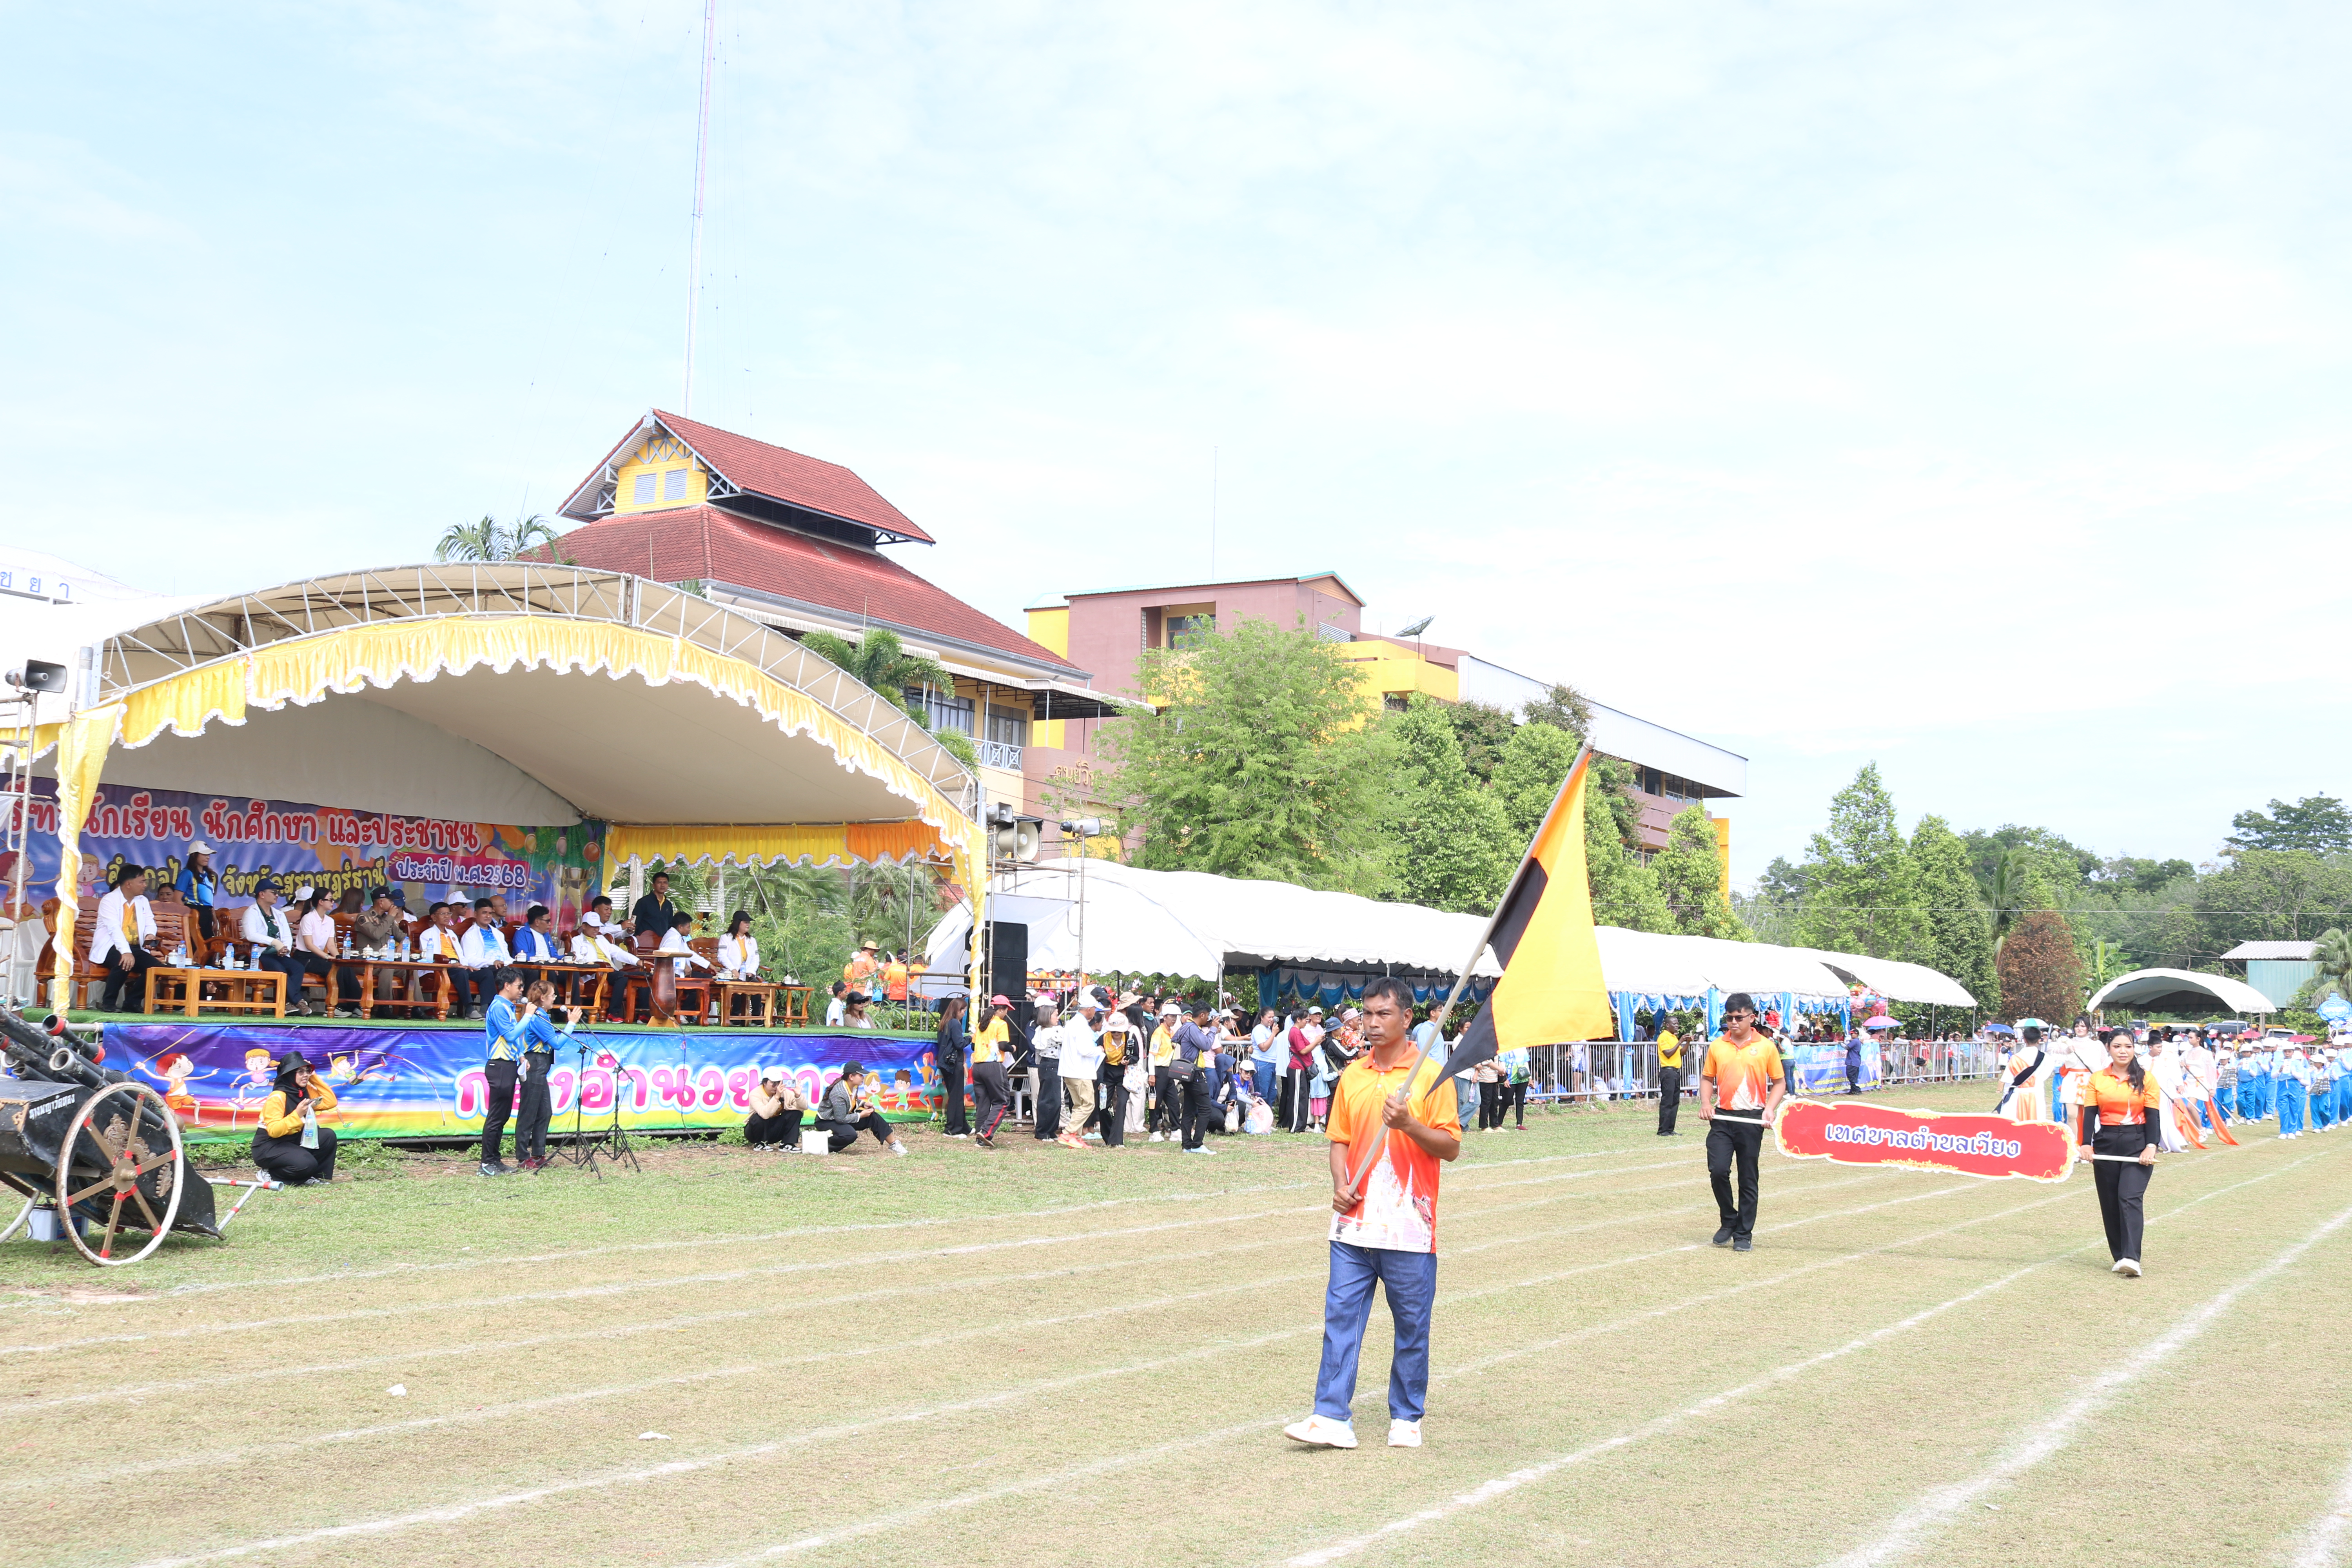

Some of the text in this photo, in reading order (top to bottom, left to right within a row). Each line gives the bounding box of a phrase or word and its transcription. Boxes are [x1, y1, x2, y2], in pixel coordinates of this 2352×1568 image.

[203, 801, 316, 840] นักศึกษา
[330, 814, 477, 849] และประชาชน
[397, 857, 525, 886] ประจำปี พ.ศ.2568
[1826, 1125, 2020, 1156] เทศบาลตำบลเวียง
